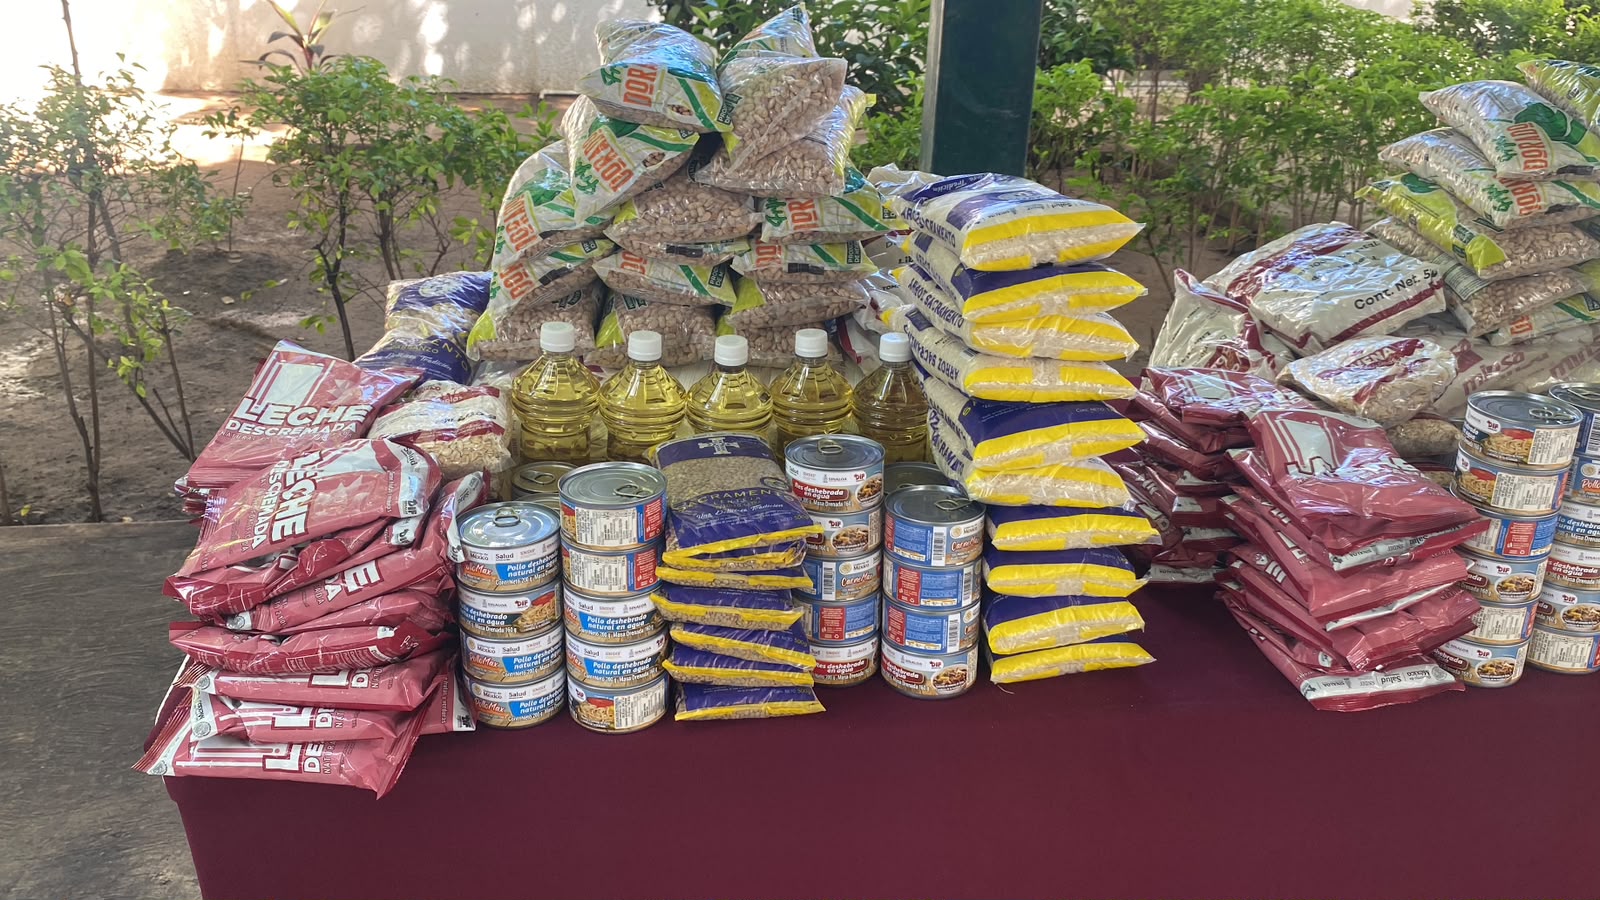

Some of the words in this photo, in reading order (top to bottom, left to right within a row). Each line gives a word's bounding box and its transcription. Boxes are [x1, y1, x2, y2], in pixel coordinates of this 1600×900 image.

[1354, 288, 1394, 310] Cont.
[1395, 274, 1421, 292] Net.
[233, 396, 375, 427] LECHE
[225, 419, 358, 437] DESCREMADA
[1488, 421, 1499, 429] DIF
[804, 485, 844, 496] deshebrada
[269, 450, 322, 545] LECHE
[251, 460, 289, 550] DESCREMADA
[507, 564, 525, 572] Pollo
[507, 567, 536, 577] natural
[1553, 562, 1598, 574] deshebrada
[470, 608, 508, 620] deshebrado
[587, 615, 604, 624] Pollo
[606, 614, 647, 624] deshebrado
[588, 623, 614, 631] natural
[627, 620, 644, 629] agua
[584, 648, 599, 656] Salud
[514, 660, 541, 669] natural
[612, 657, 652, 669] deshebrado
[827, 660, 865, 669] deshebrada
[632, 664, 649, 674] agua
[1381, 676, 1402, 684] Salud
[520, 704, 546, 714] natural
